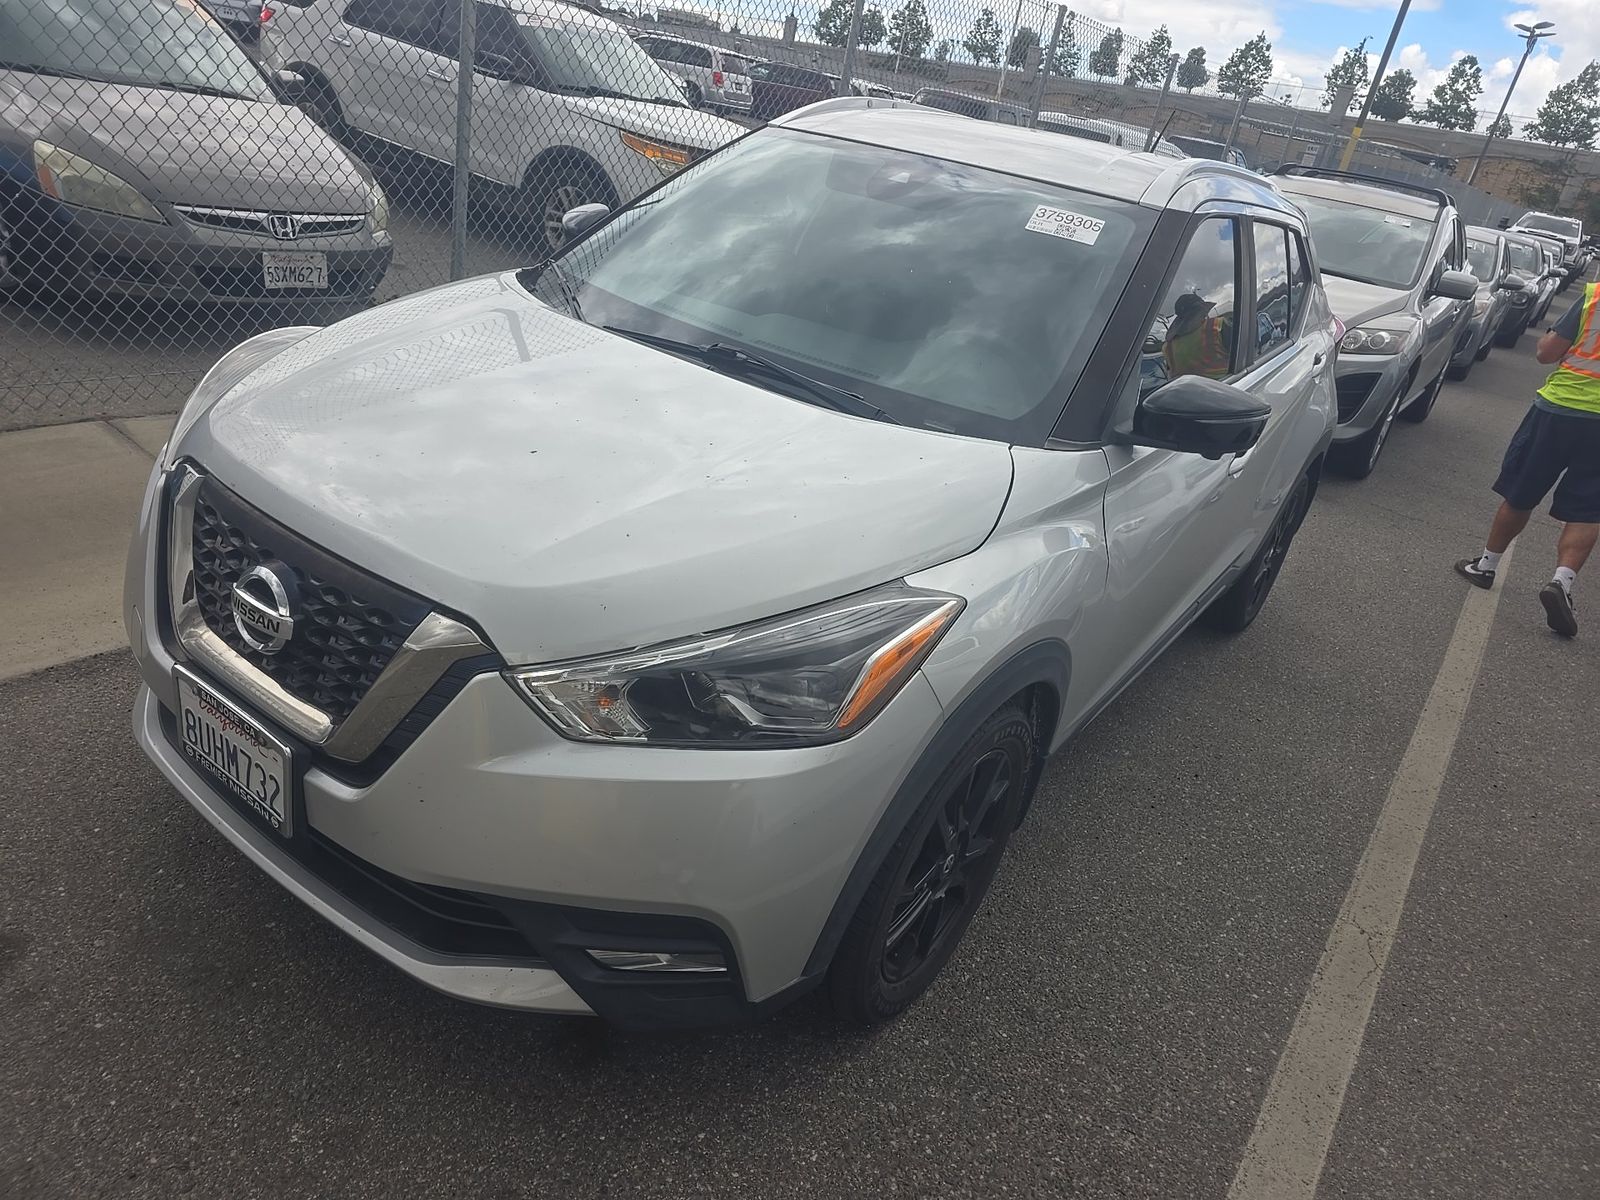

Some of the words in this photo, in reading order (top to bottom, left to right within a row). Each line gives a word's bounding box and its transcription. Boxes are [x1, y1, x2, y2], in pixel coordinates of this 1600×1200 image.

[1036, 208, 1103, 232] 3759305
[266, 266, 322, 283] 5SXM627
[232, 597, 280, 633] NISSAN
[201, 691, 217, 708] SAN
[244, 724, 256, 738] CA
[184, 707, 283, 820] 8UHM732
[195, 751, 228, 786] PREMIER
[229, 782, 270, 822] NISSAN
